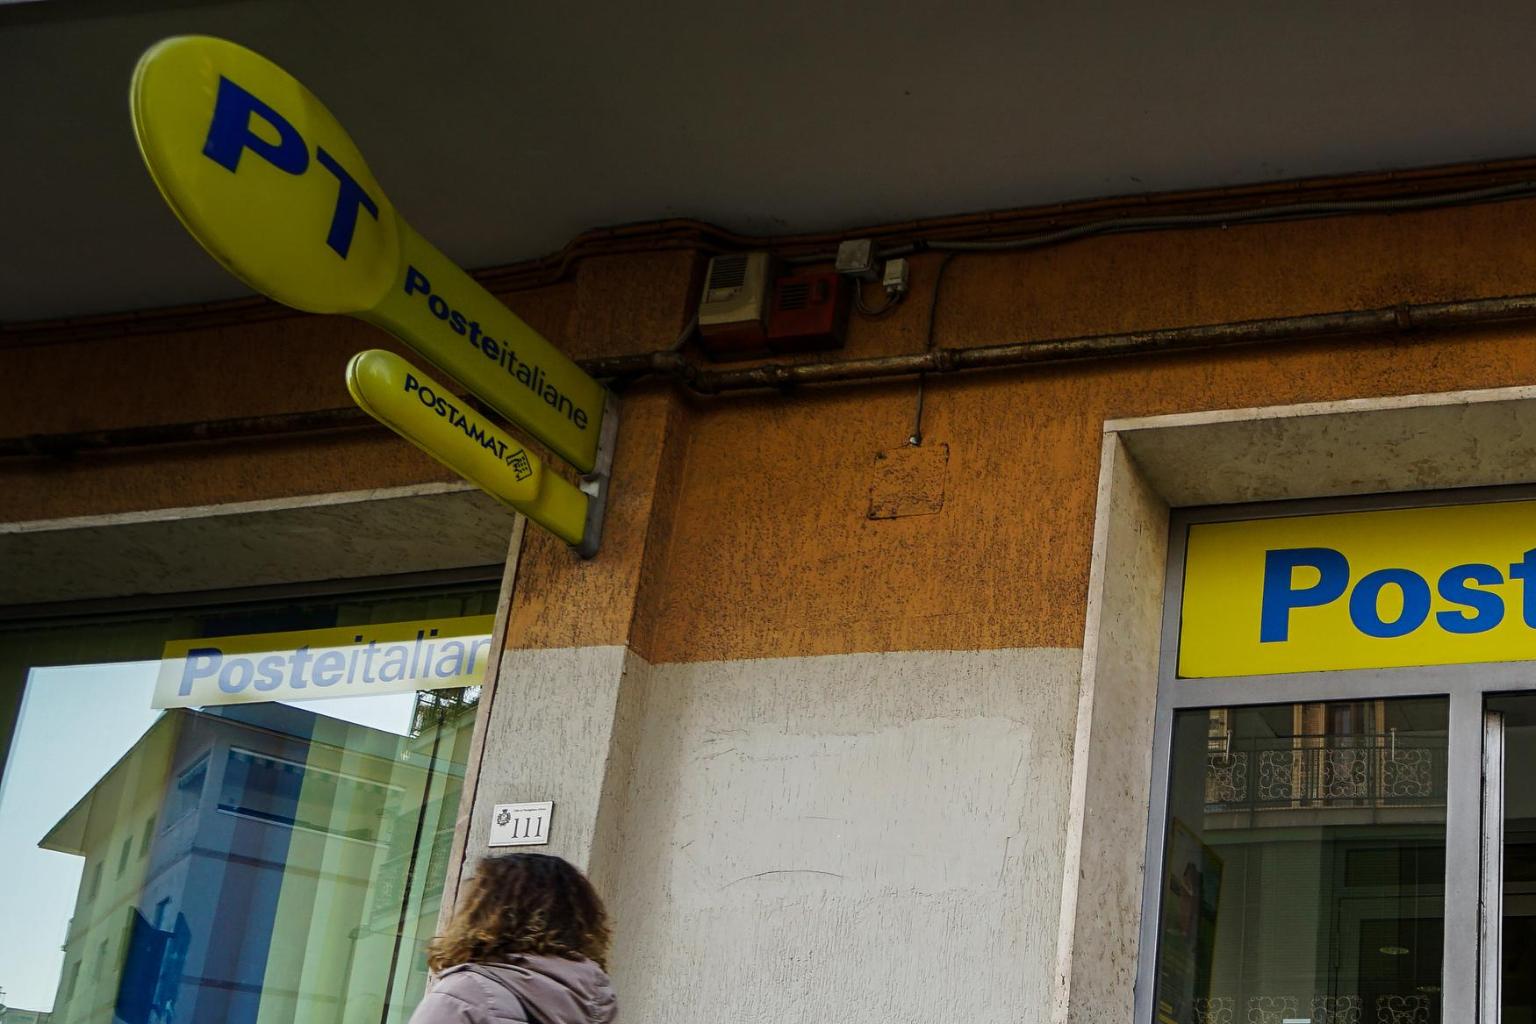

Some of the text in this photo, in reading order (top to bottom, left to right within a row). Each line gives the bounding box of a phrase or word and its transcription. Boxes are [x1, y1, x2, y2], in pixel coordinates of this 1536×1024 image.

[202, 75, 379, 260] PT
[404, 264, 588, 430] Posteitaliane
[404, 373, 508, 459] POSTAMAT
[511, 816, 542, 838] 111
